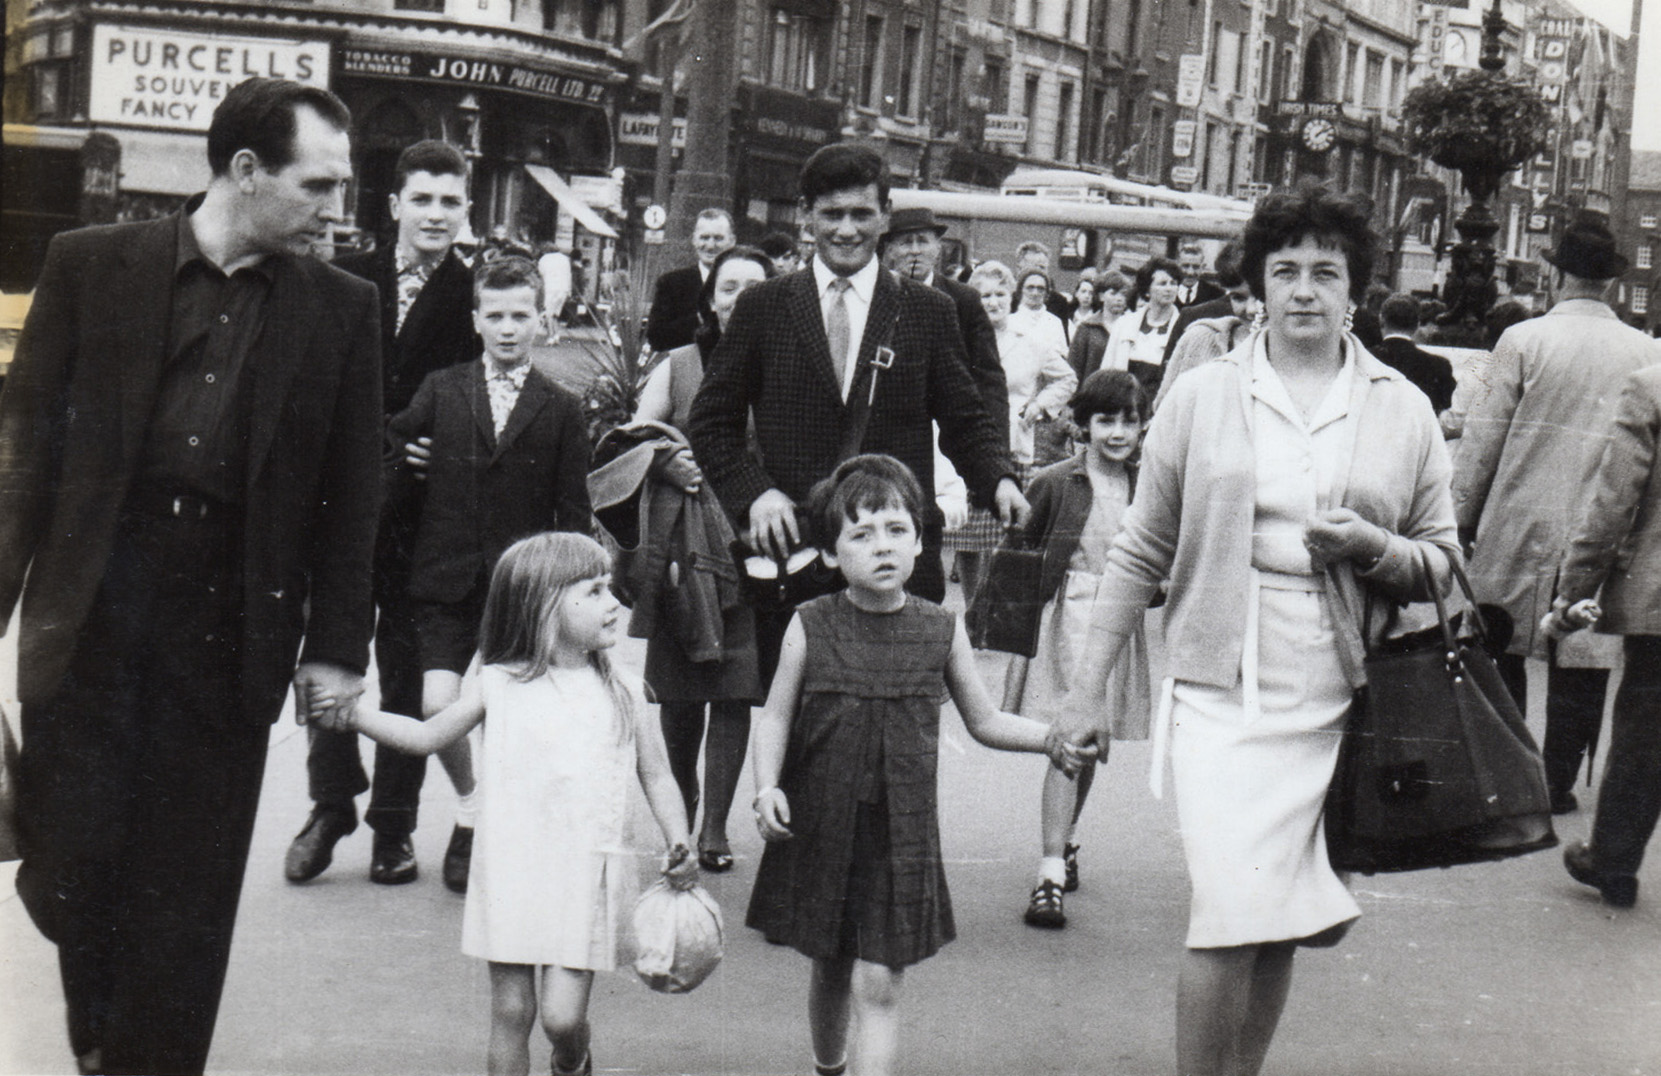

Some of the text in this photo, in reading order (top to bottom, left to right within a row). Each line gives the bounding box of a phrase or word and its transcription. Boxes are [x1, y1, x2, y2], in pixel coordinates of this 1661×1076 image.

[108, 38, 314, 80] PURCELLS
[430, 58, 504, 83] JOHN
[508, 68, 560, 94] PURCELL
[120, 98, 198, 121] FANCY
[1308, 103, 1337, 115] TIMES
[1528, 41, 1564, 230] DONLLYS
